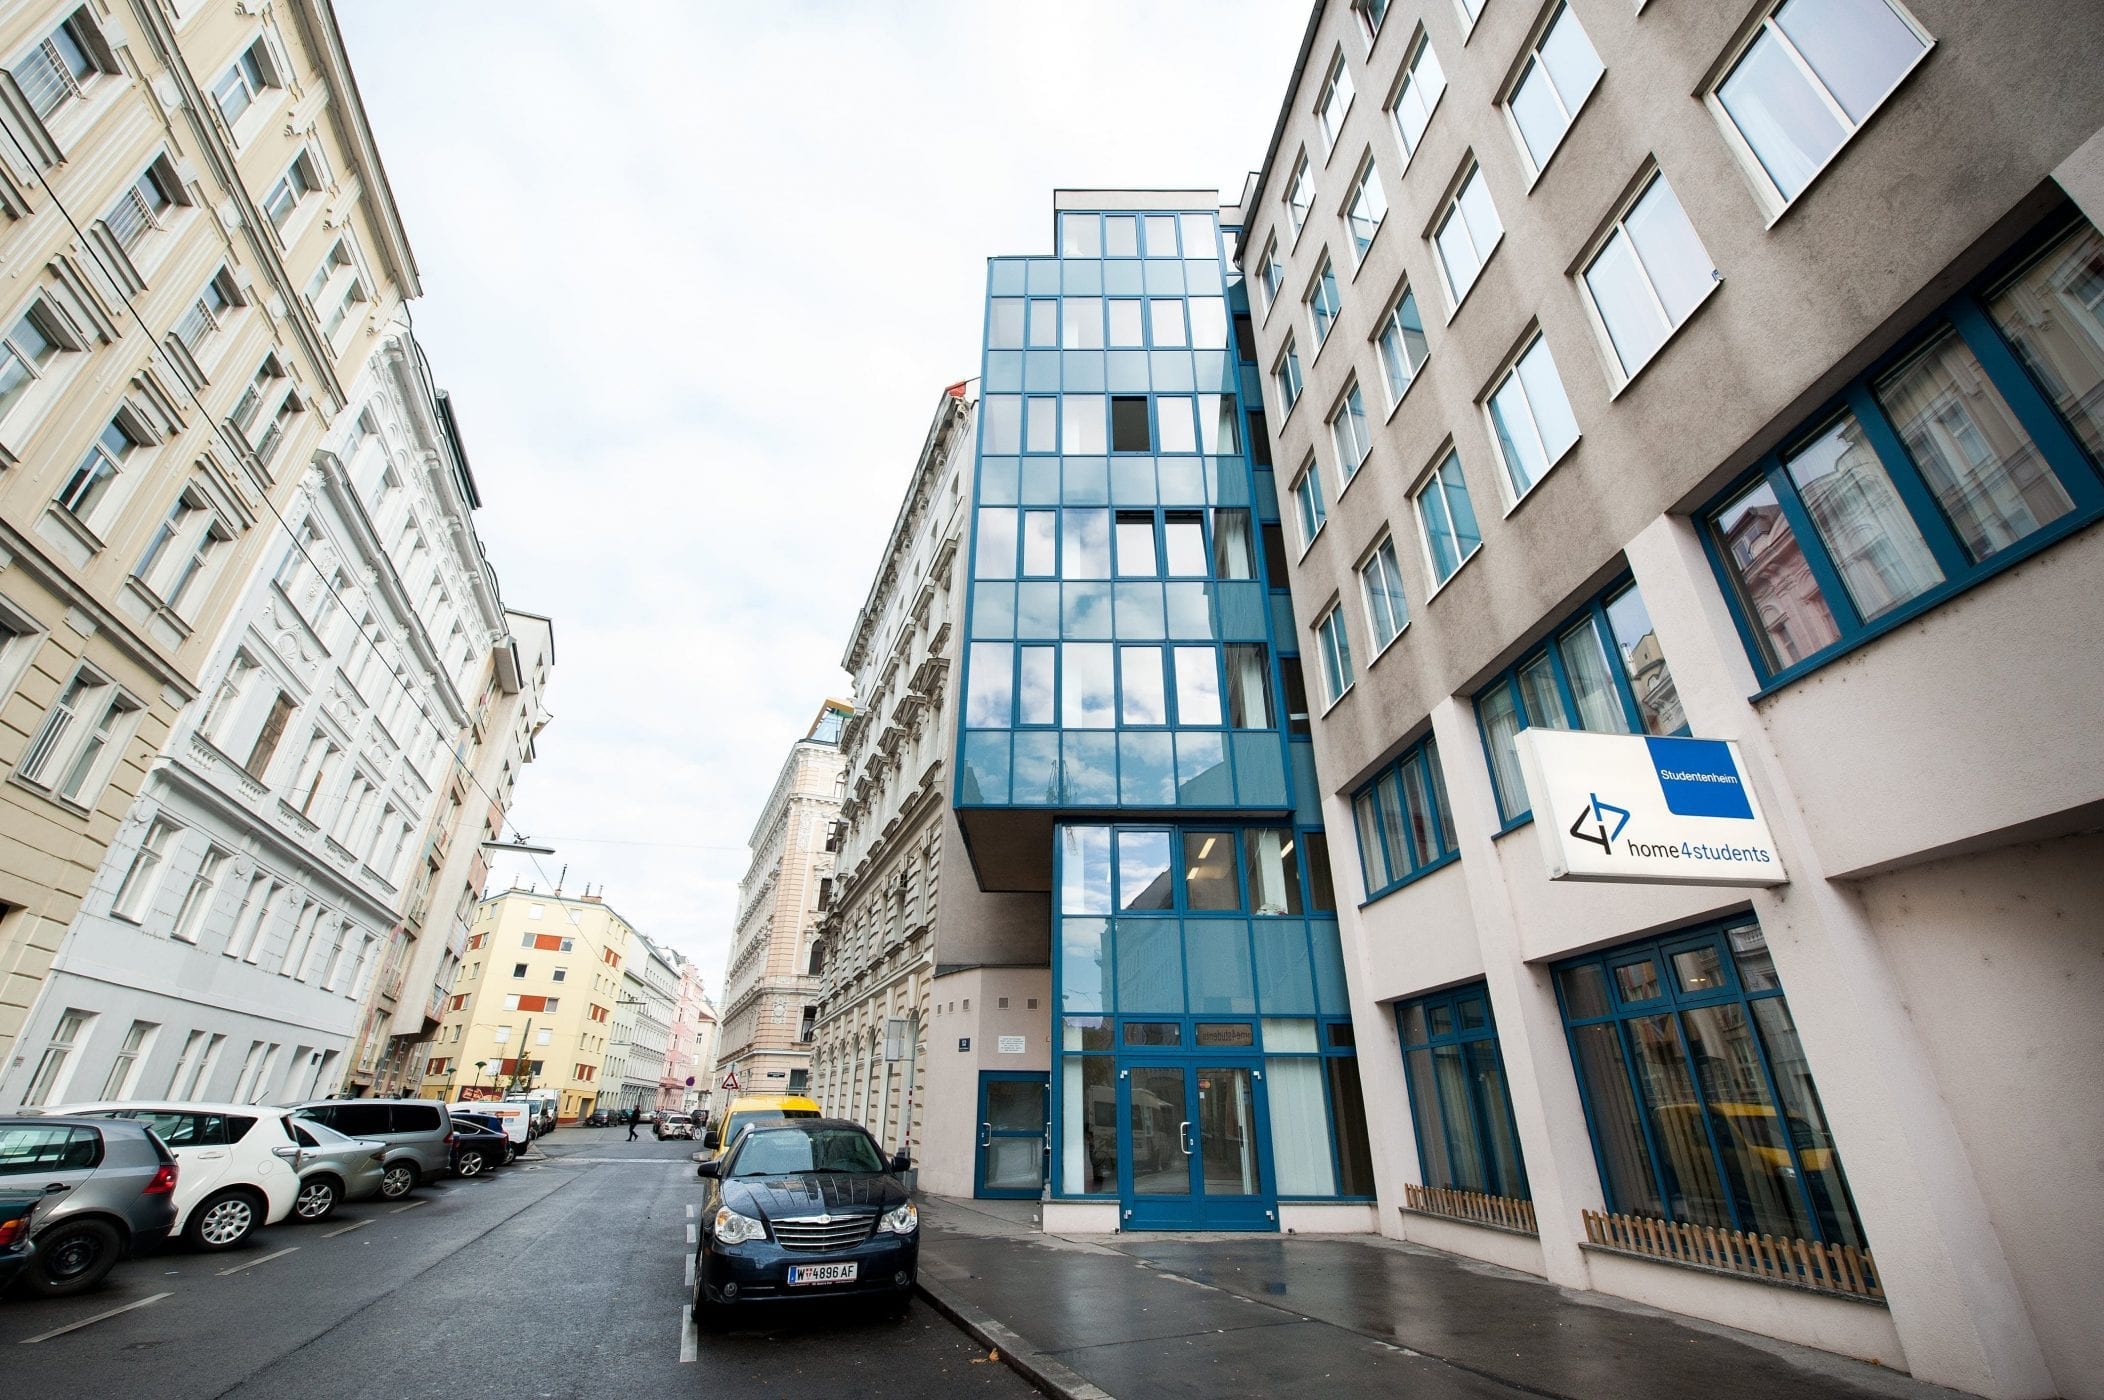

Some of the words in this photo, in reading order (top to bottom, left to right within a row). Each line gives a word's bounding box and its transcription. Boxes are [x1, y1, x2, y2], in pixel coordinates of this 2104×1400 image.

[1661, 769, 1738, 785] Studentenheim
[1627, 839, 1771, 863] home4students
[797, 1269, 805, 1281] W
[813, 1266, 839, 1279] 4896
[840, 1265, 854, 1278] AF
